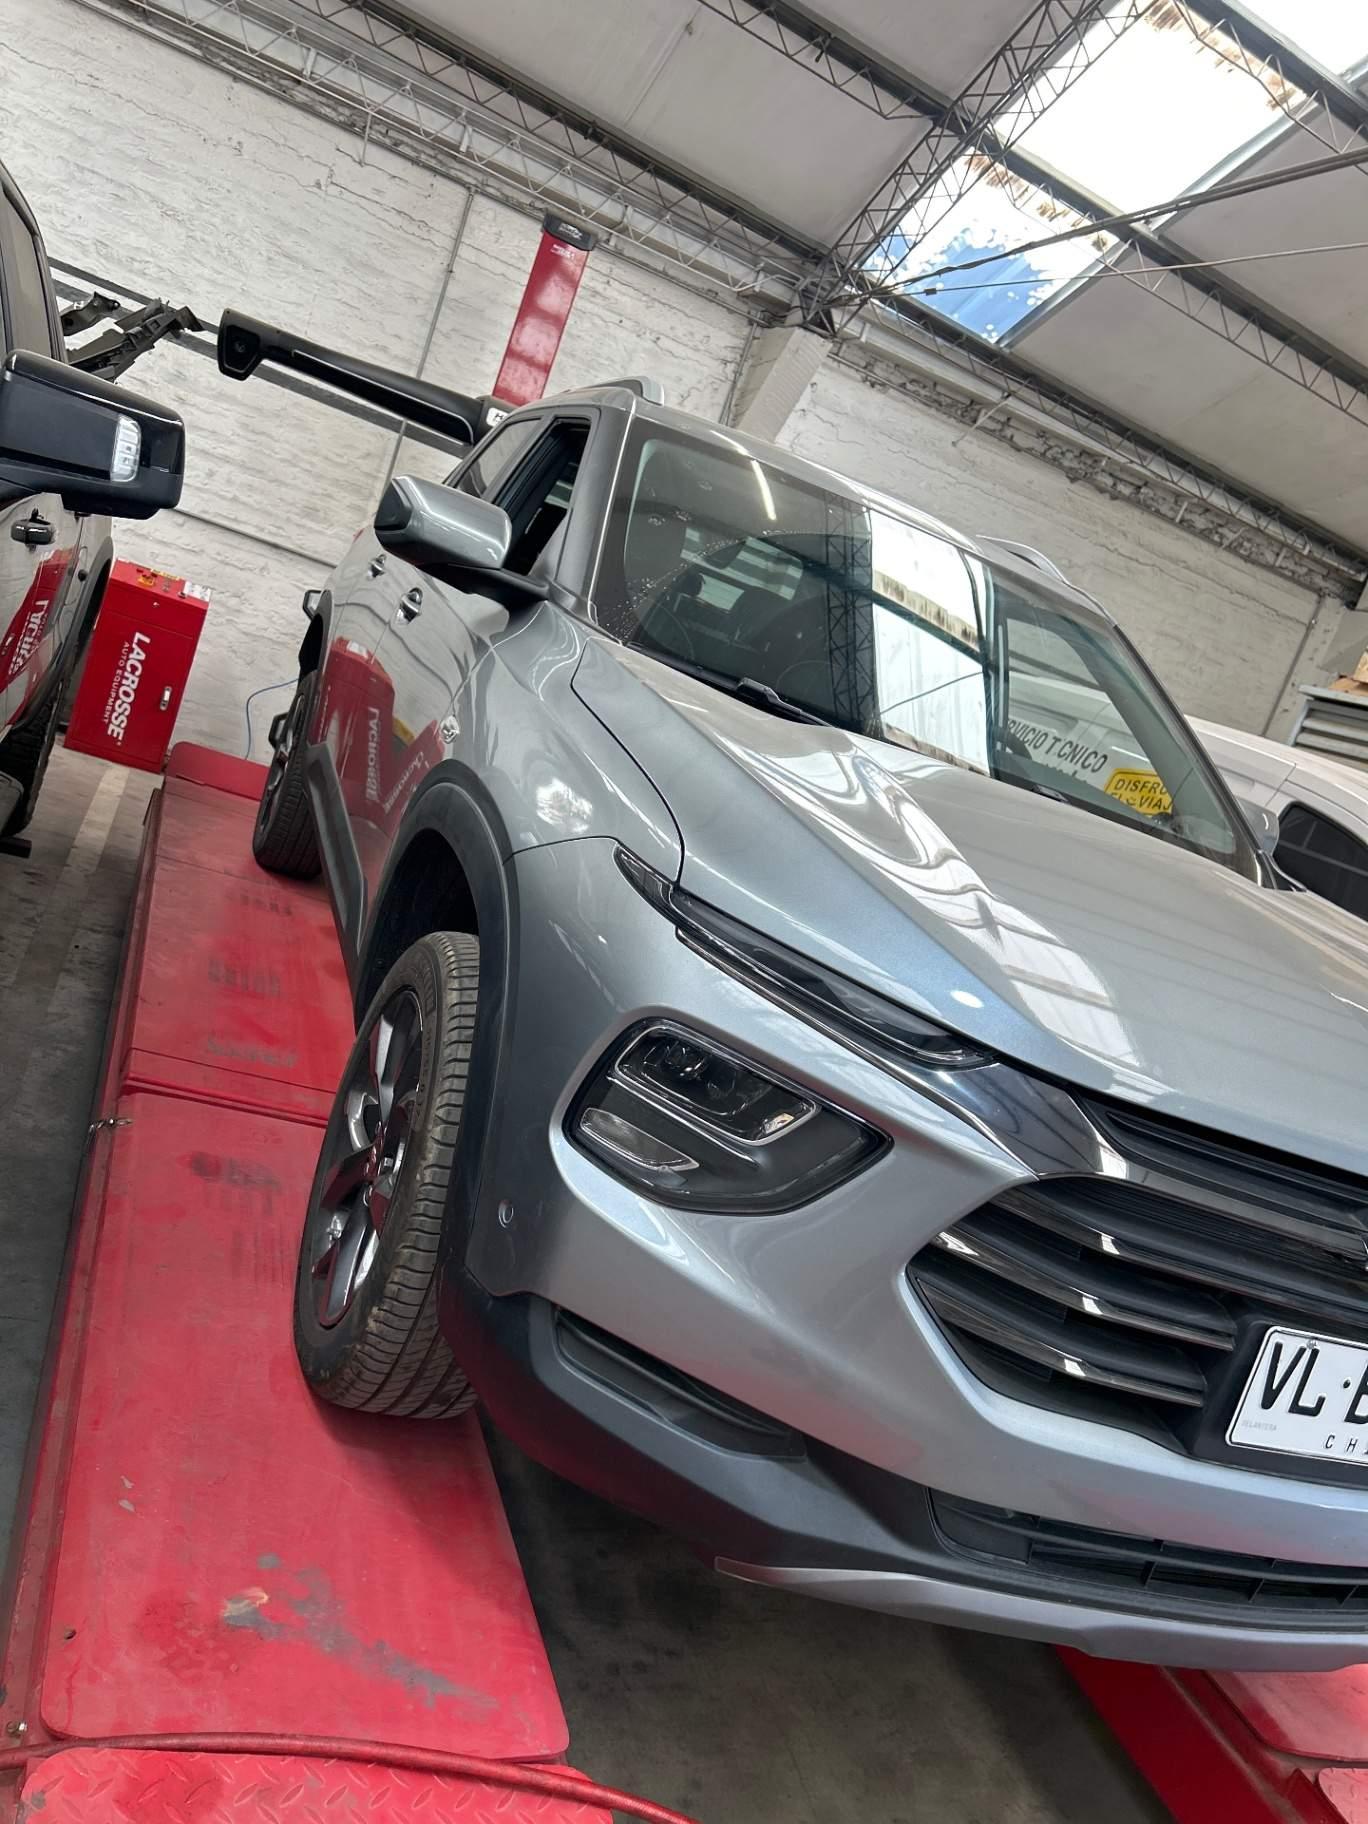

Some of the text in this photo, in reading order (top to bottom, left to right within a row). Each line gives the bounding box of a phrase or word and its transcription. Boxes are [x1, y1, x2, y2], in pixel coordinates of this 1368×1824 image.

[103, 641, 130, 723] AUTO EQUIPMENT
[107, 632, 150, 740] LACROSSE
[1007, 717, 1049, 750] RVICIO
[1045, 736, 1108, 774] TCNICO
[1114, 778, 1168, 795] DISFRU
[1139, 795, 1172, 811] VIAJ
[1324, 1433, 1368, 1456] CH
